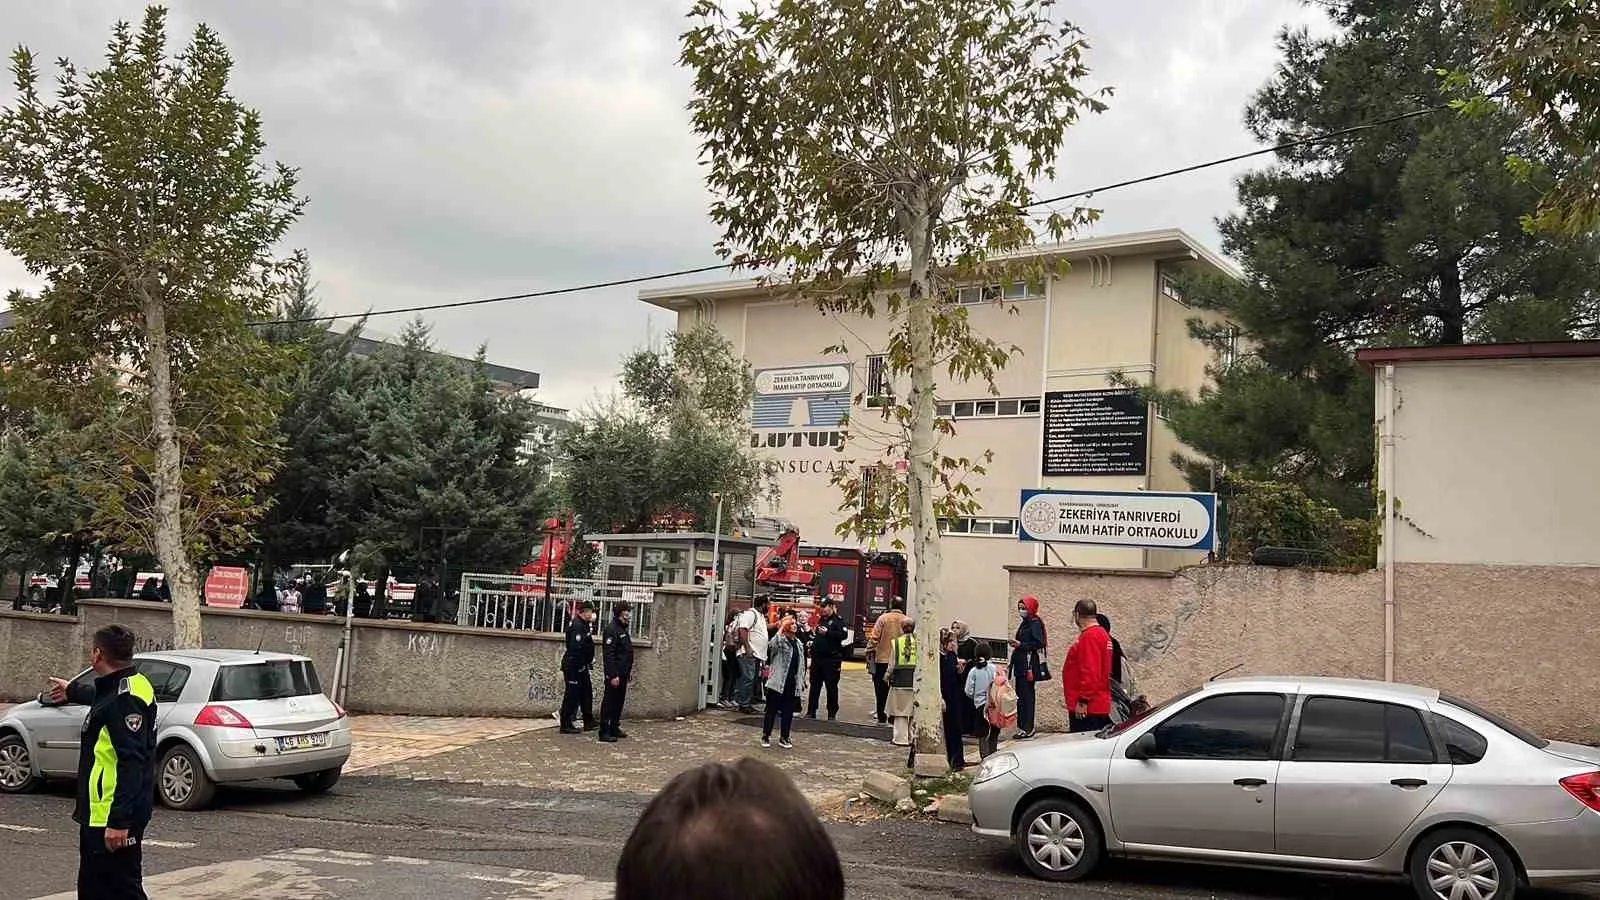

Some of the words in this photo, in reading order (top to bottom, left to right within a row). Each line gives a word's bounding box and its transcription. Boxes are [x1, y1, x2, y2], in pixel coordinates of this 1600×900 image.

[1059, 508, 1110, 522] ZEKERİYA
[1112, 510, 1181, 524] TANRIVERDİ
[1058, 522, 1090, 535] İMAM
[1092, 524, 1125, 537] HATİP
[1127, 526, 1198, 539] ORTAOKULU
[831, 584, 843, 594] 112
